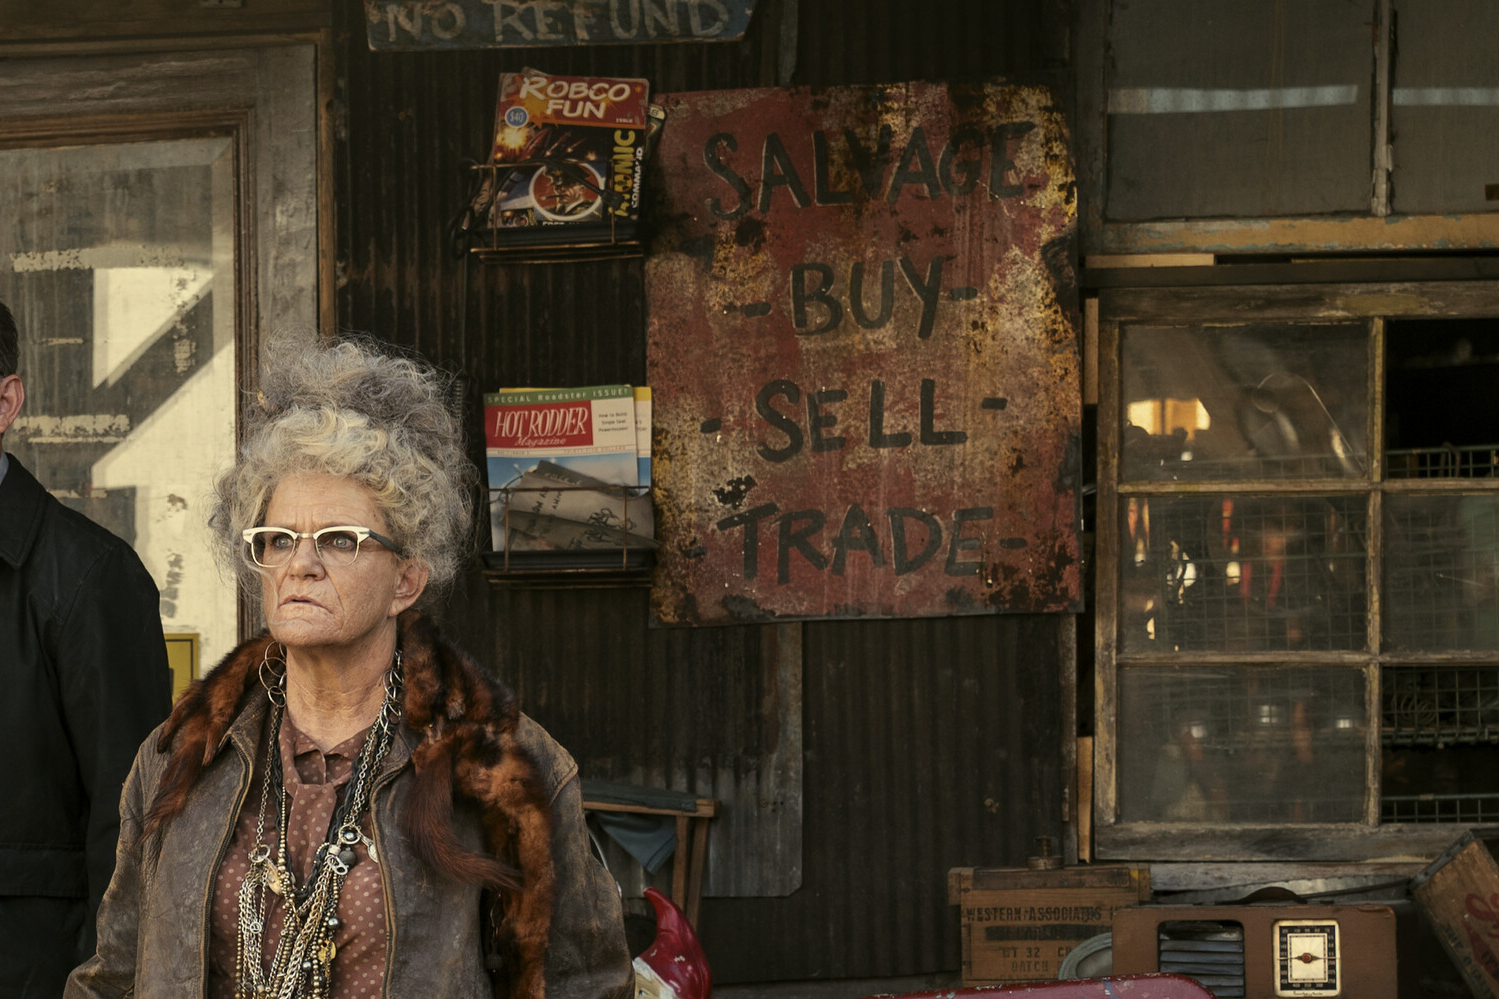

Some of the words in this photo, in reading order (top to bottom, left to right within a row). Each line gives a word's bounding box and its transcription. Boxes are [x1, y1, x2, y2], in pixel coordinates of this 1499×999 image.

[387, 0, 466, 42] NO
[493, 0, 730, 41] REFUND
[519, 76, 631, 102] ROBCO
[545, 99, 606, 119] FUN
[703, 119, 1035, 221] SALVAGE
[788, 256, 946, 340] BUY
[486, 395, 531, 404] SPECIAL
[537, 391, 586, 402] Roadster
[494, 411, 528, 438] HOT
[527, 406, 588, 438] RODDER
[755, 377, 968, 463] SELL
[514, 436, 567, 448] Magazine
[717, 502, 995, 585] TRADE
